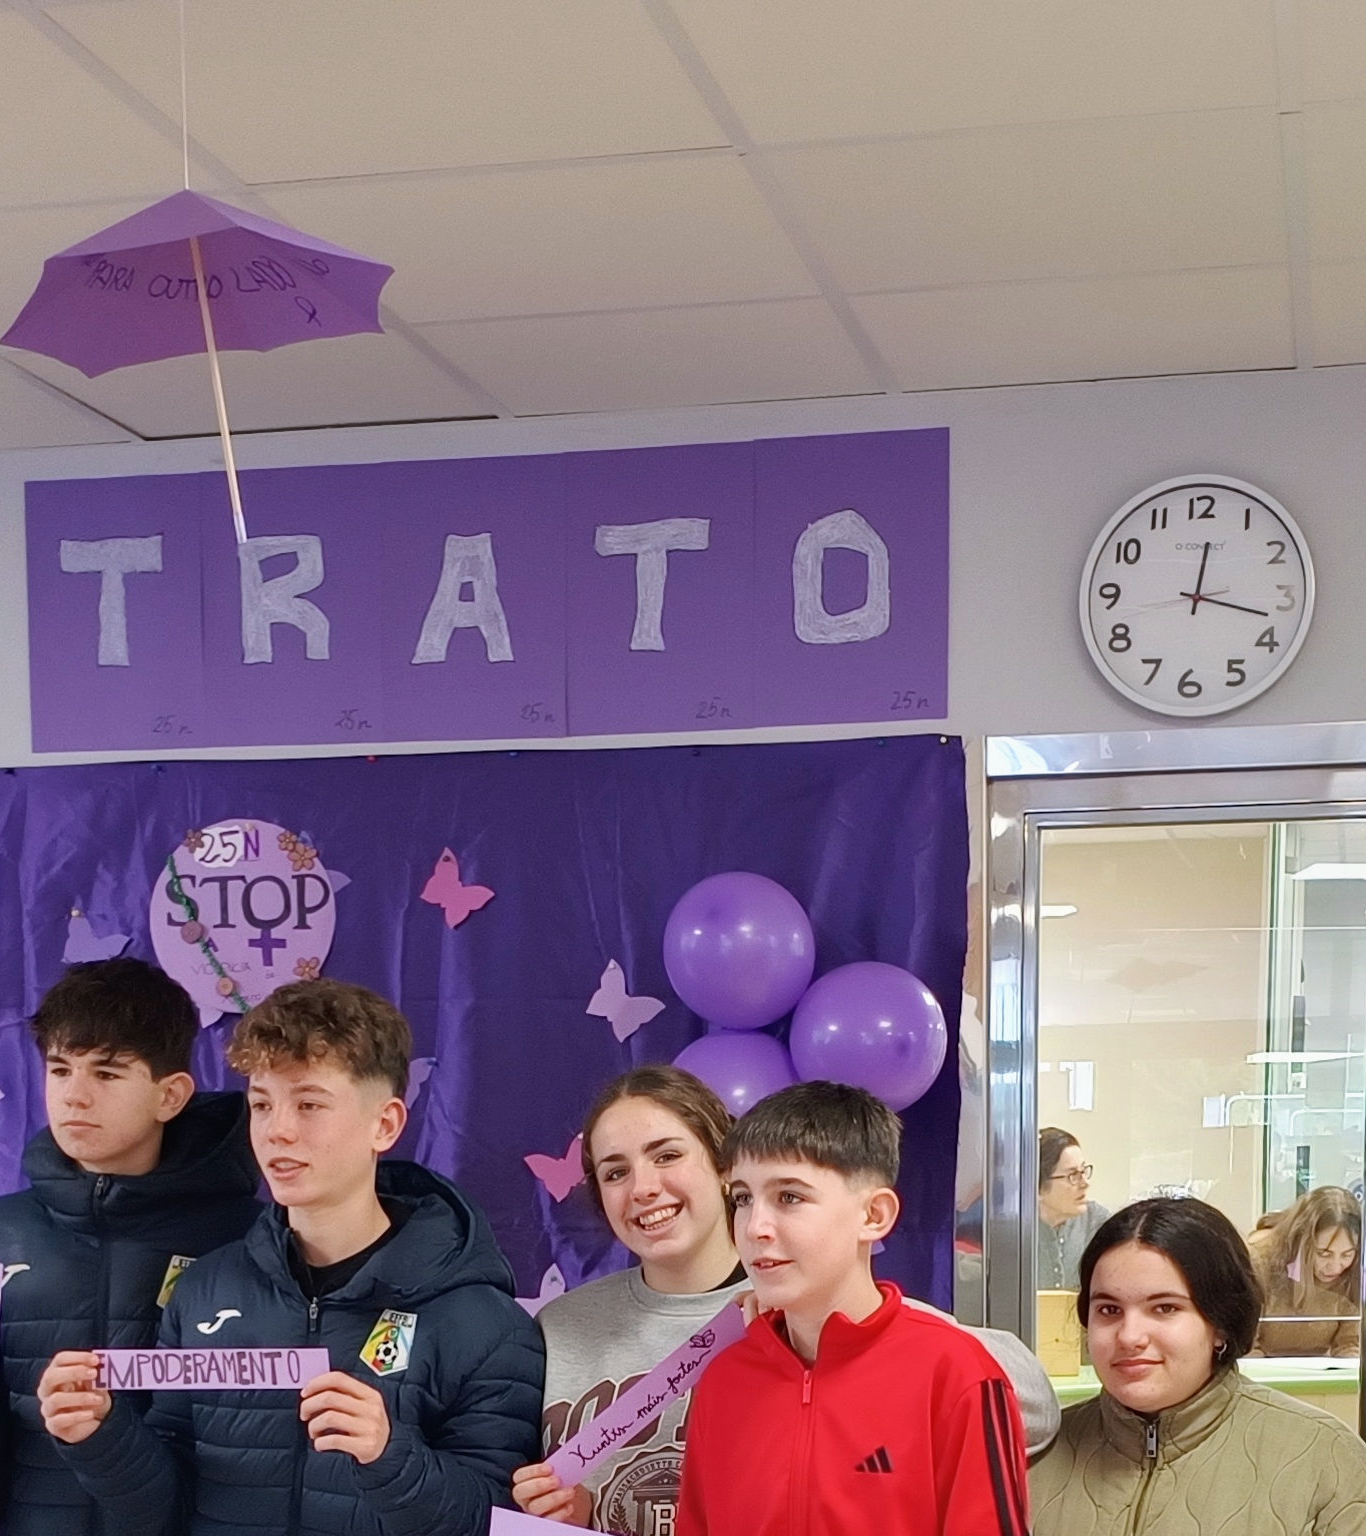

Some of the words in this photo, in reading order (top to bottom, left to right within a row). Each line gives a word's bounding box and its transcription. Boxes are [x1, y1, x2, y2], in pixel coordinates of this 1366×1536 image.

[1150, 507, 1168, 530] 11
[1188, 495, 1216, 520] 12
[1244, 507, 1251, 531] 1
[1115, 538, 1142, 564] 10
[1266, 540, 1287, 564] 2
[60, 508, 891, 666] TRATO
[1098, 582, 1121, 610] 9
[1276, 584, 1296, 612] 3
[1108, 623, 1132, 653] 8
[1254, 626, 1280, 654] 4
[1141, 658, 1163, 686] 7
[1177, 668, 1202, 698] 6
[1225, 659, 1246, 687] 5
[165, 873, 331, 931] STOP
